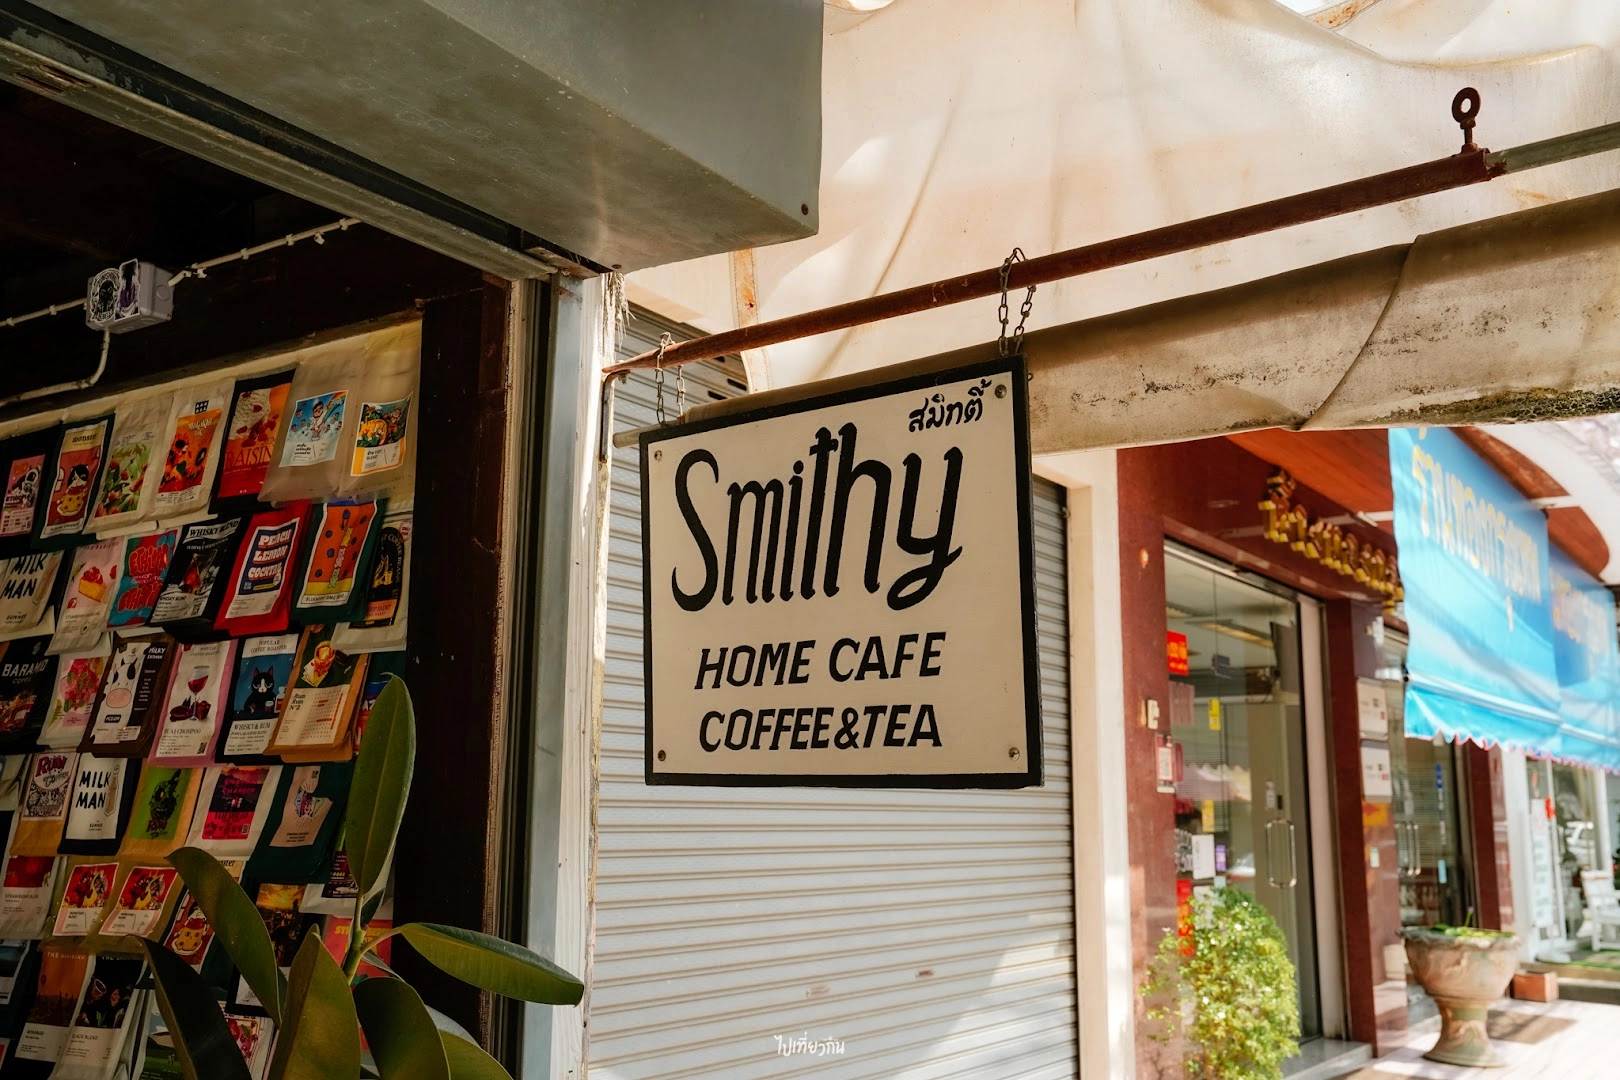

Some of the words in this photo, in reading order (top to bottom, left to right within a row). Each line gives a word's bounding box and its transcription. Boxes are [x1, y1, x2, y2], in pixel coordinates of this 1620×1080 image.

[672, 422, 964, 612] Smithy
[190, 527, 221, 537] WHISKY
[258, 529, 293, 548] PEACH
[11, 553, 48, 575] MILK
[252, 545, 289, 564] LEMON
[0, 578, 38, 599] MAN
[694, 639, 817, 691] HOME
[829, 631, 946, 682] CAFE
[79, 771, 112, 789] MILK
[75, 791, 107, 809] MAN
